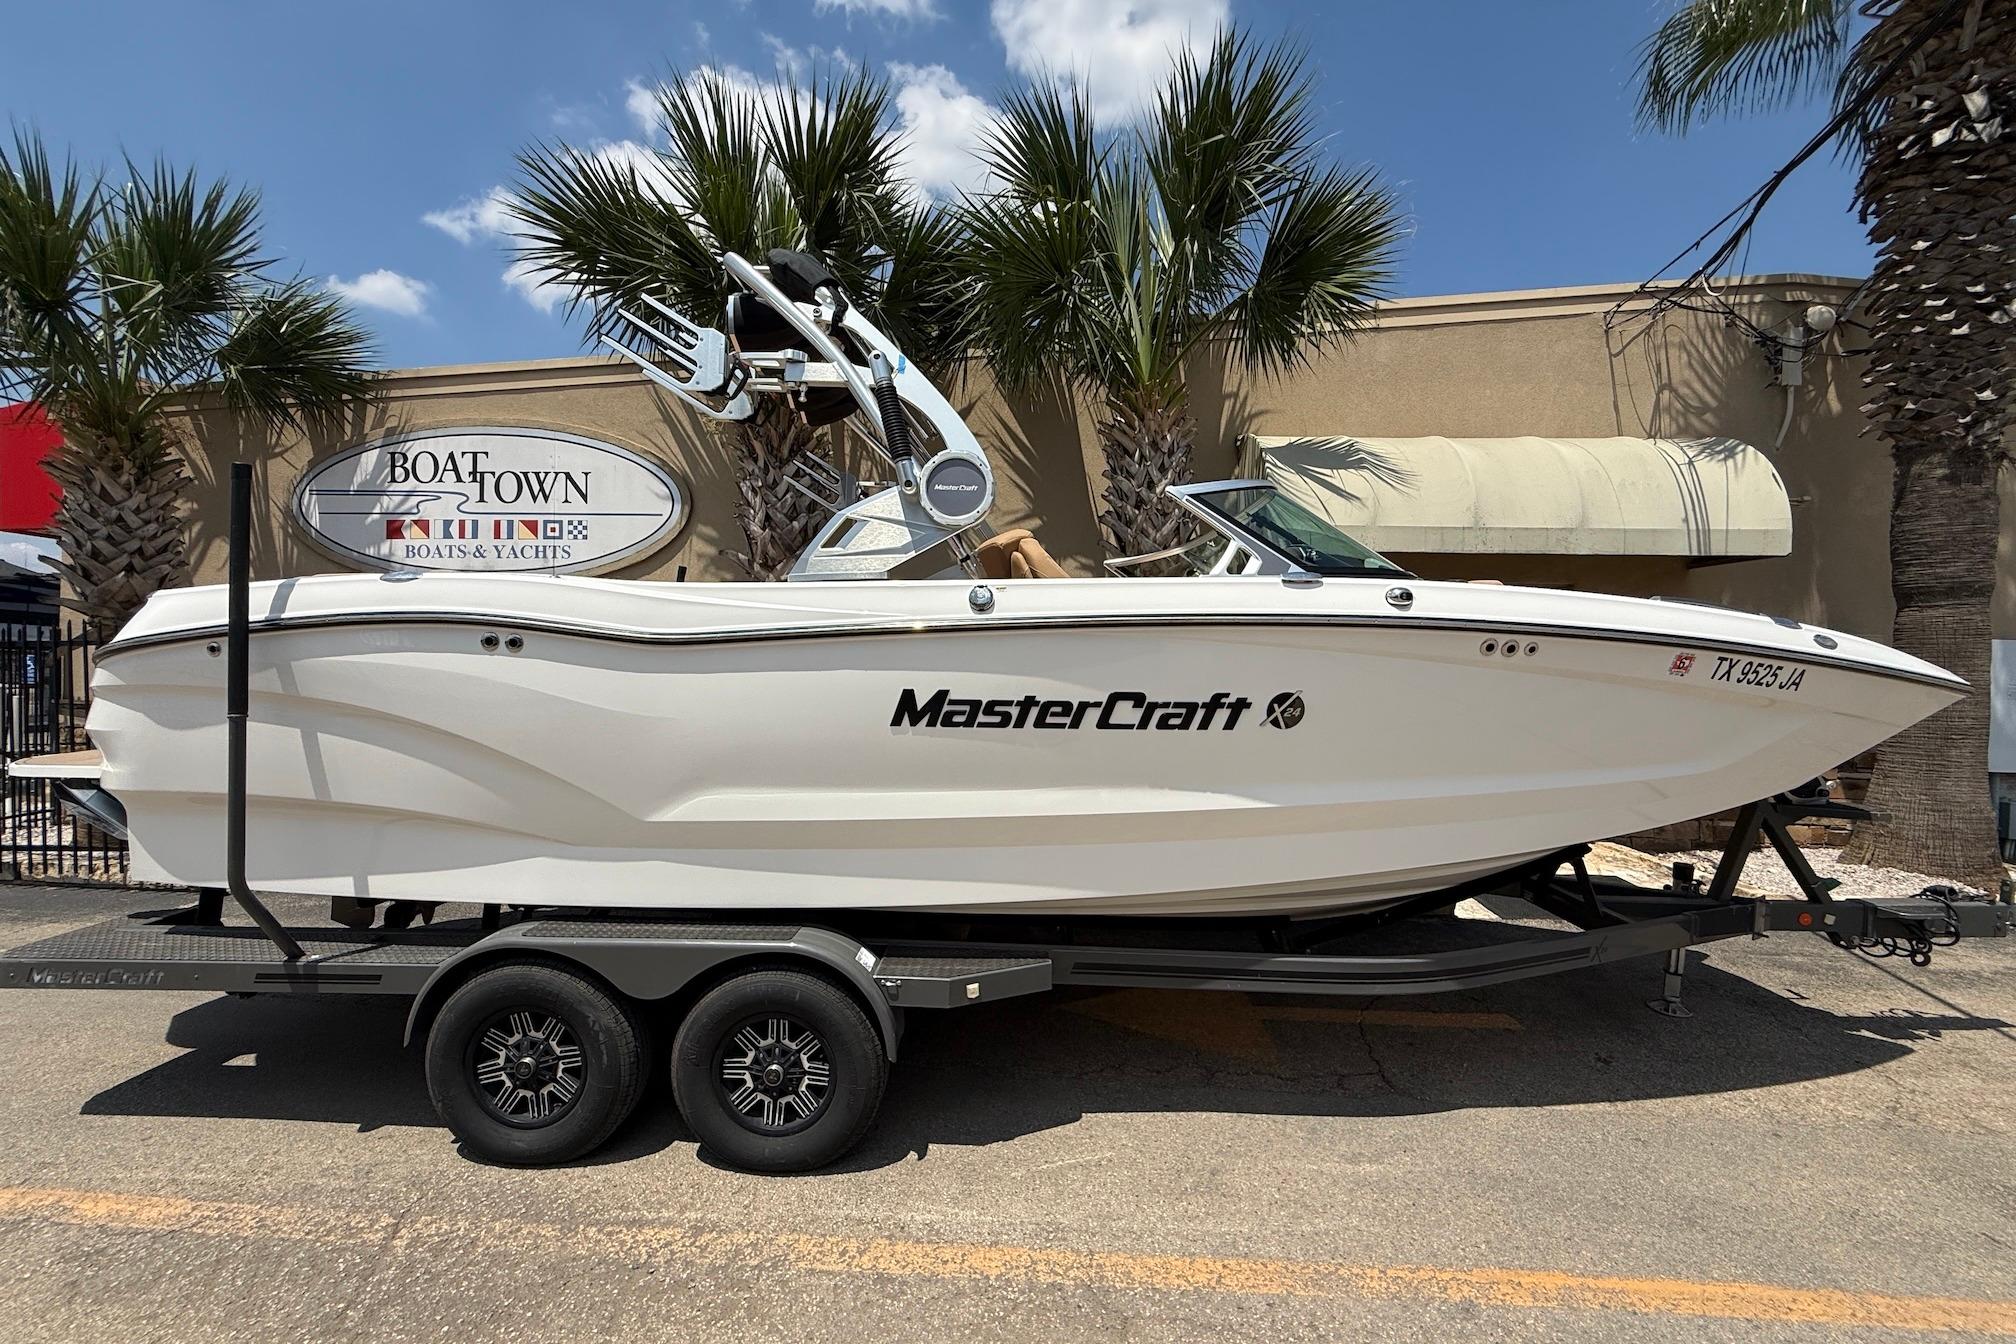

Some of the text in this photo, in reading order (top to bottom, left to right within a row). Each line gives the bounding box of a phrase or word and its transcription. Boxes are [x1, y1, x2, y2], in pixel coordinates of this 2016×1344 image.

[387, 451, 592, 504] BOAT TOWN
[934, 483, 979, 491] MasterCraft
[405, 544, 571, 560] BOATS & YACHTS
[1711, 656, 1806, 692] TX 9525 JA
[889, 688, 1253, 731] MasterCraft
[26, 967, 165, 985] MasterCraft
